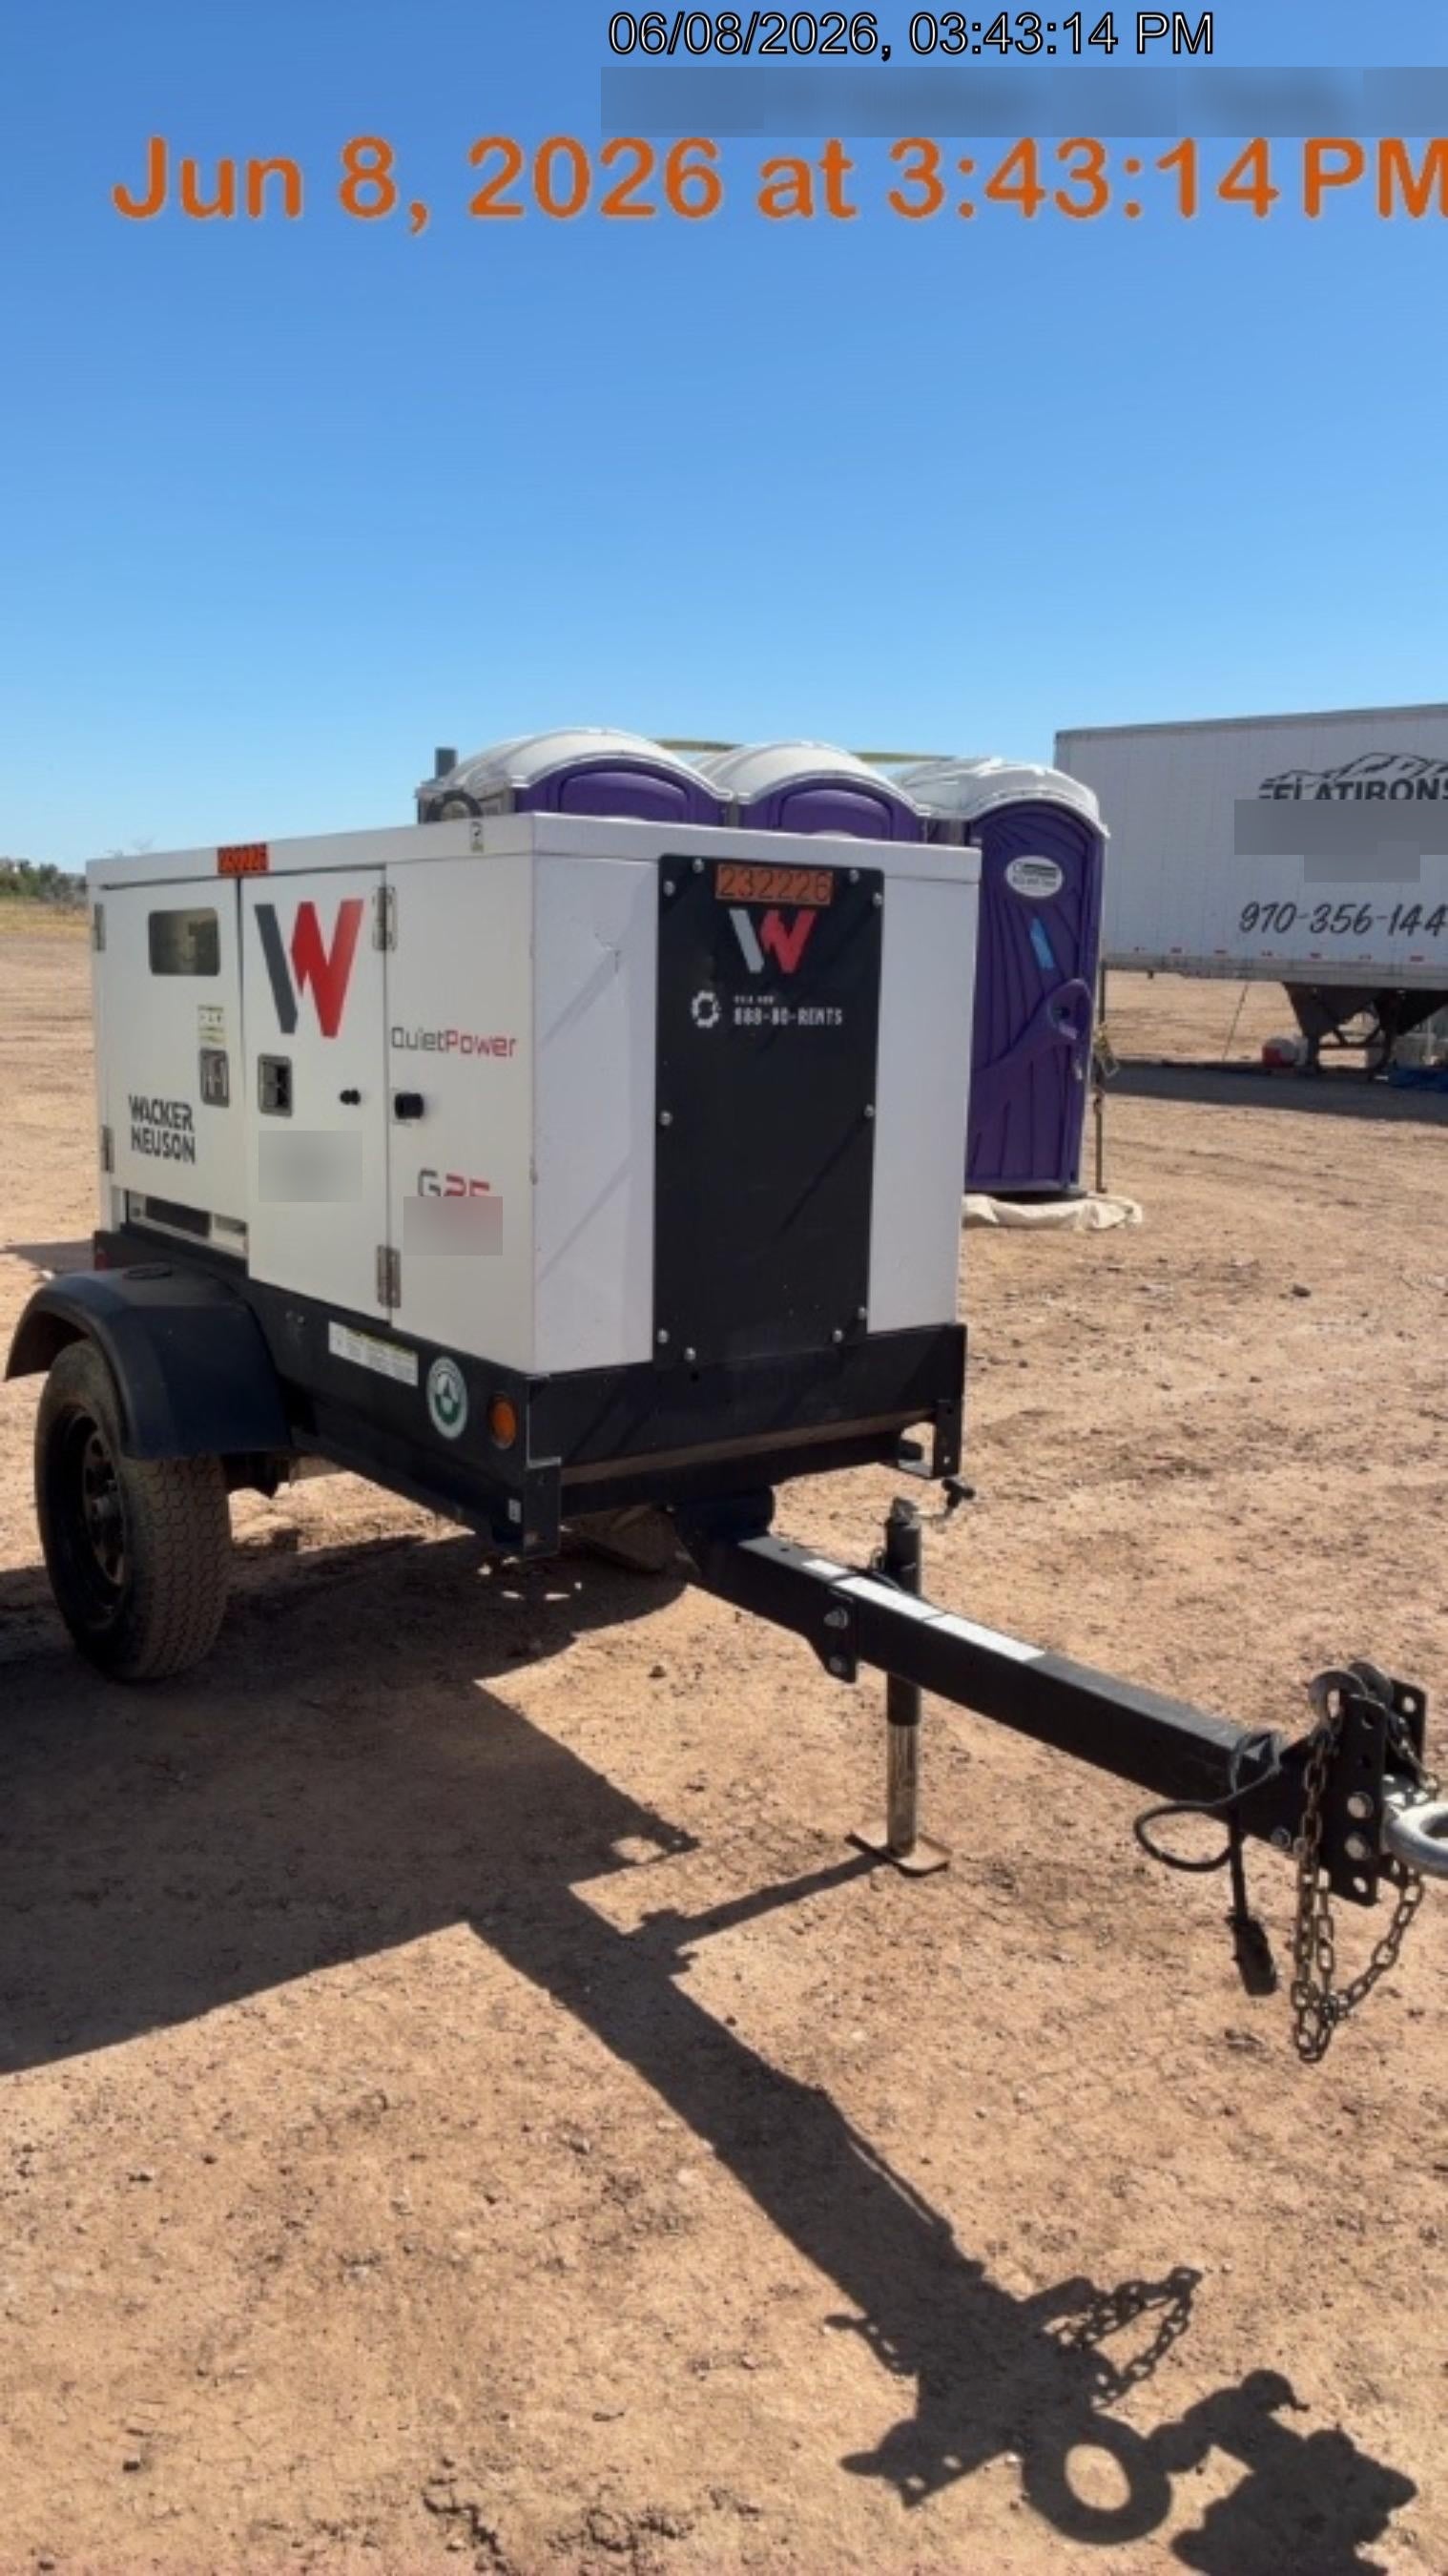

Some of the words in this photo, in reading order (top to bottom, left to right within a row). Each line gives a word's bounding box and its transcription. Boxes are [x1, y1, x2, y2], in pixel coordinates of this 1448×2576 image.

[1272, 778, 1448, 800] FLATIRON
[720, 865, 831, 901] 232226
[391, 1026, 517, 1057] QuietPower
[128, 1093, 195, 1132] WACKER
[131, 1125, 197, 1164] NEUSON
